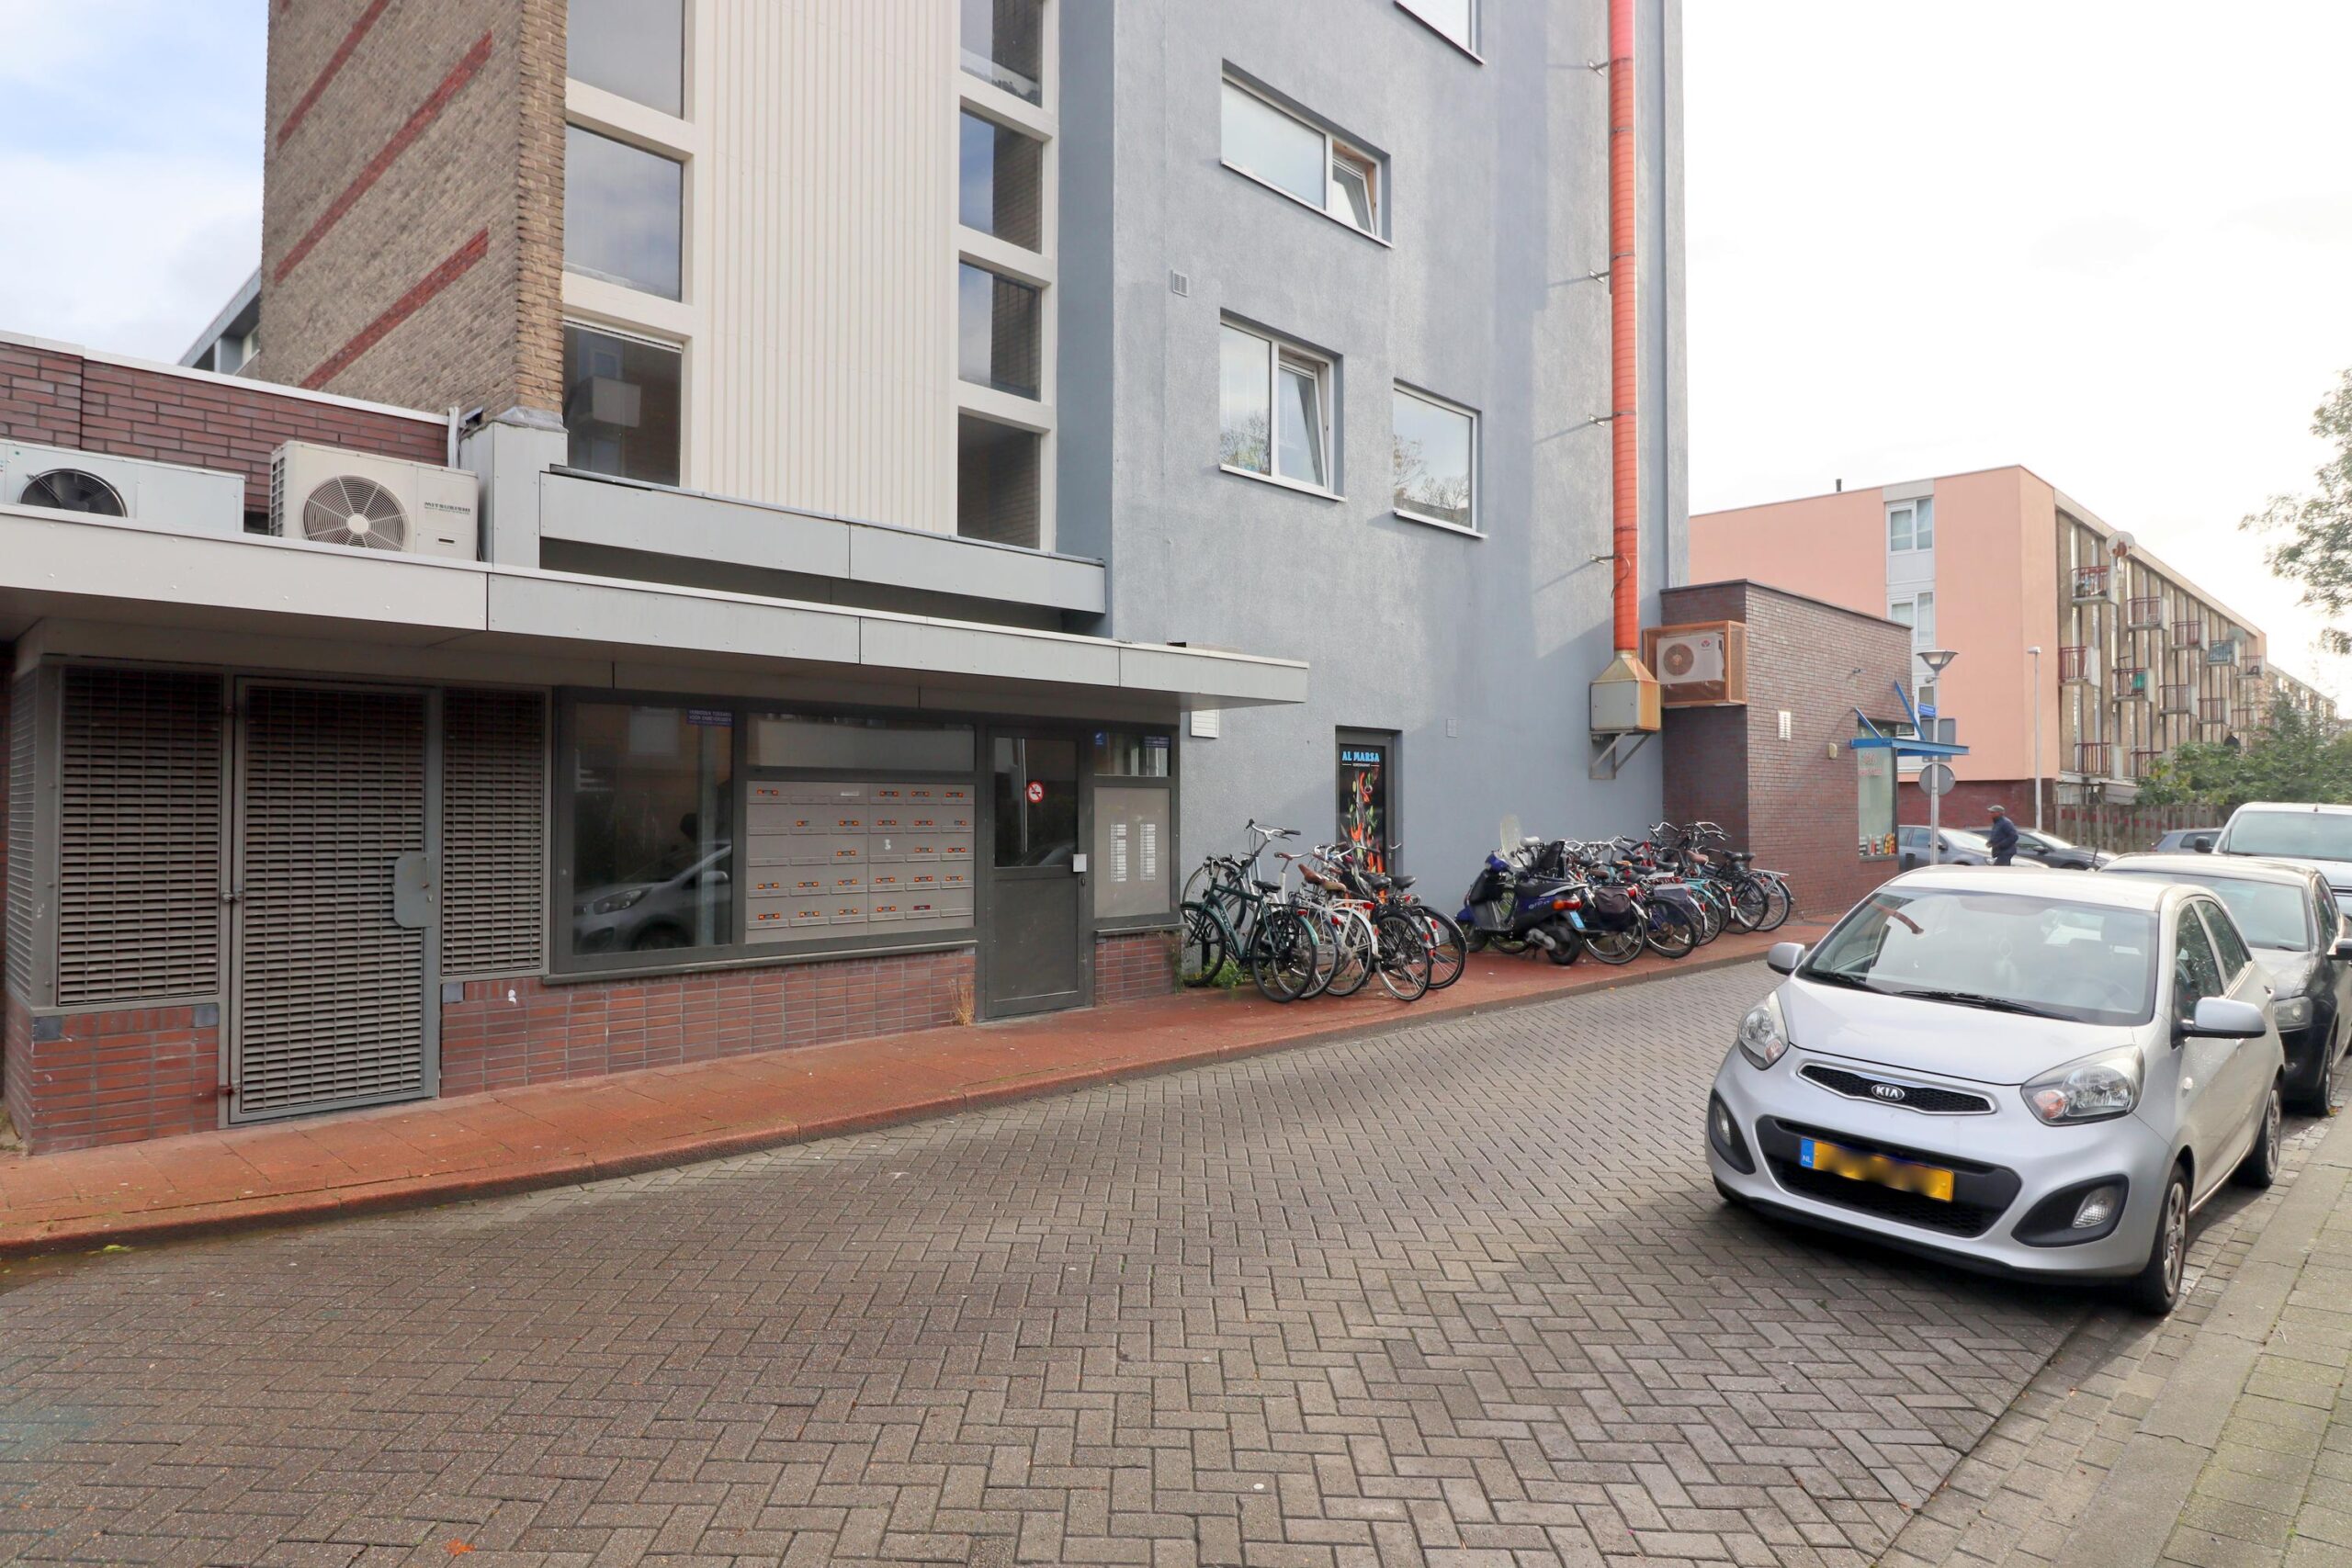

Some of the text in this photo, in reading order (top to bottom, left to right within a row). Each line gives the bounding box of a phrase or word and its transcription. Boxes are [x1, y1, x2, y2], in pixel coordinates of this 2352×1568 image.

[424, 502, 470, 513] MITSUBISHI
[1341, 750, 1380, 762] AL MARSA
[1876, 1086, 1899, 1098] KIA
[1802, 1155, 1813, 1164] NL
